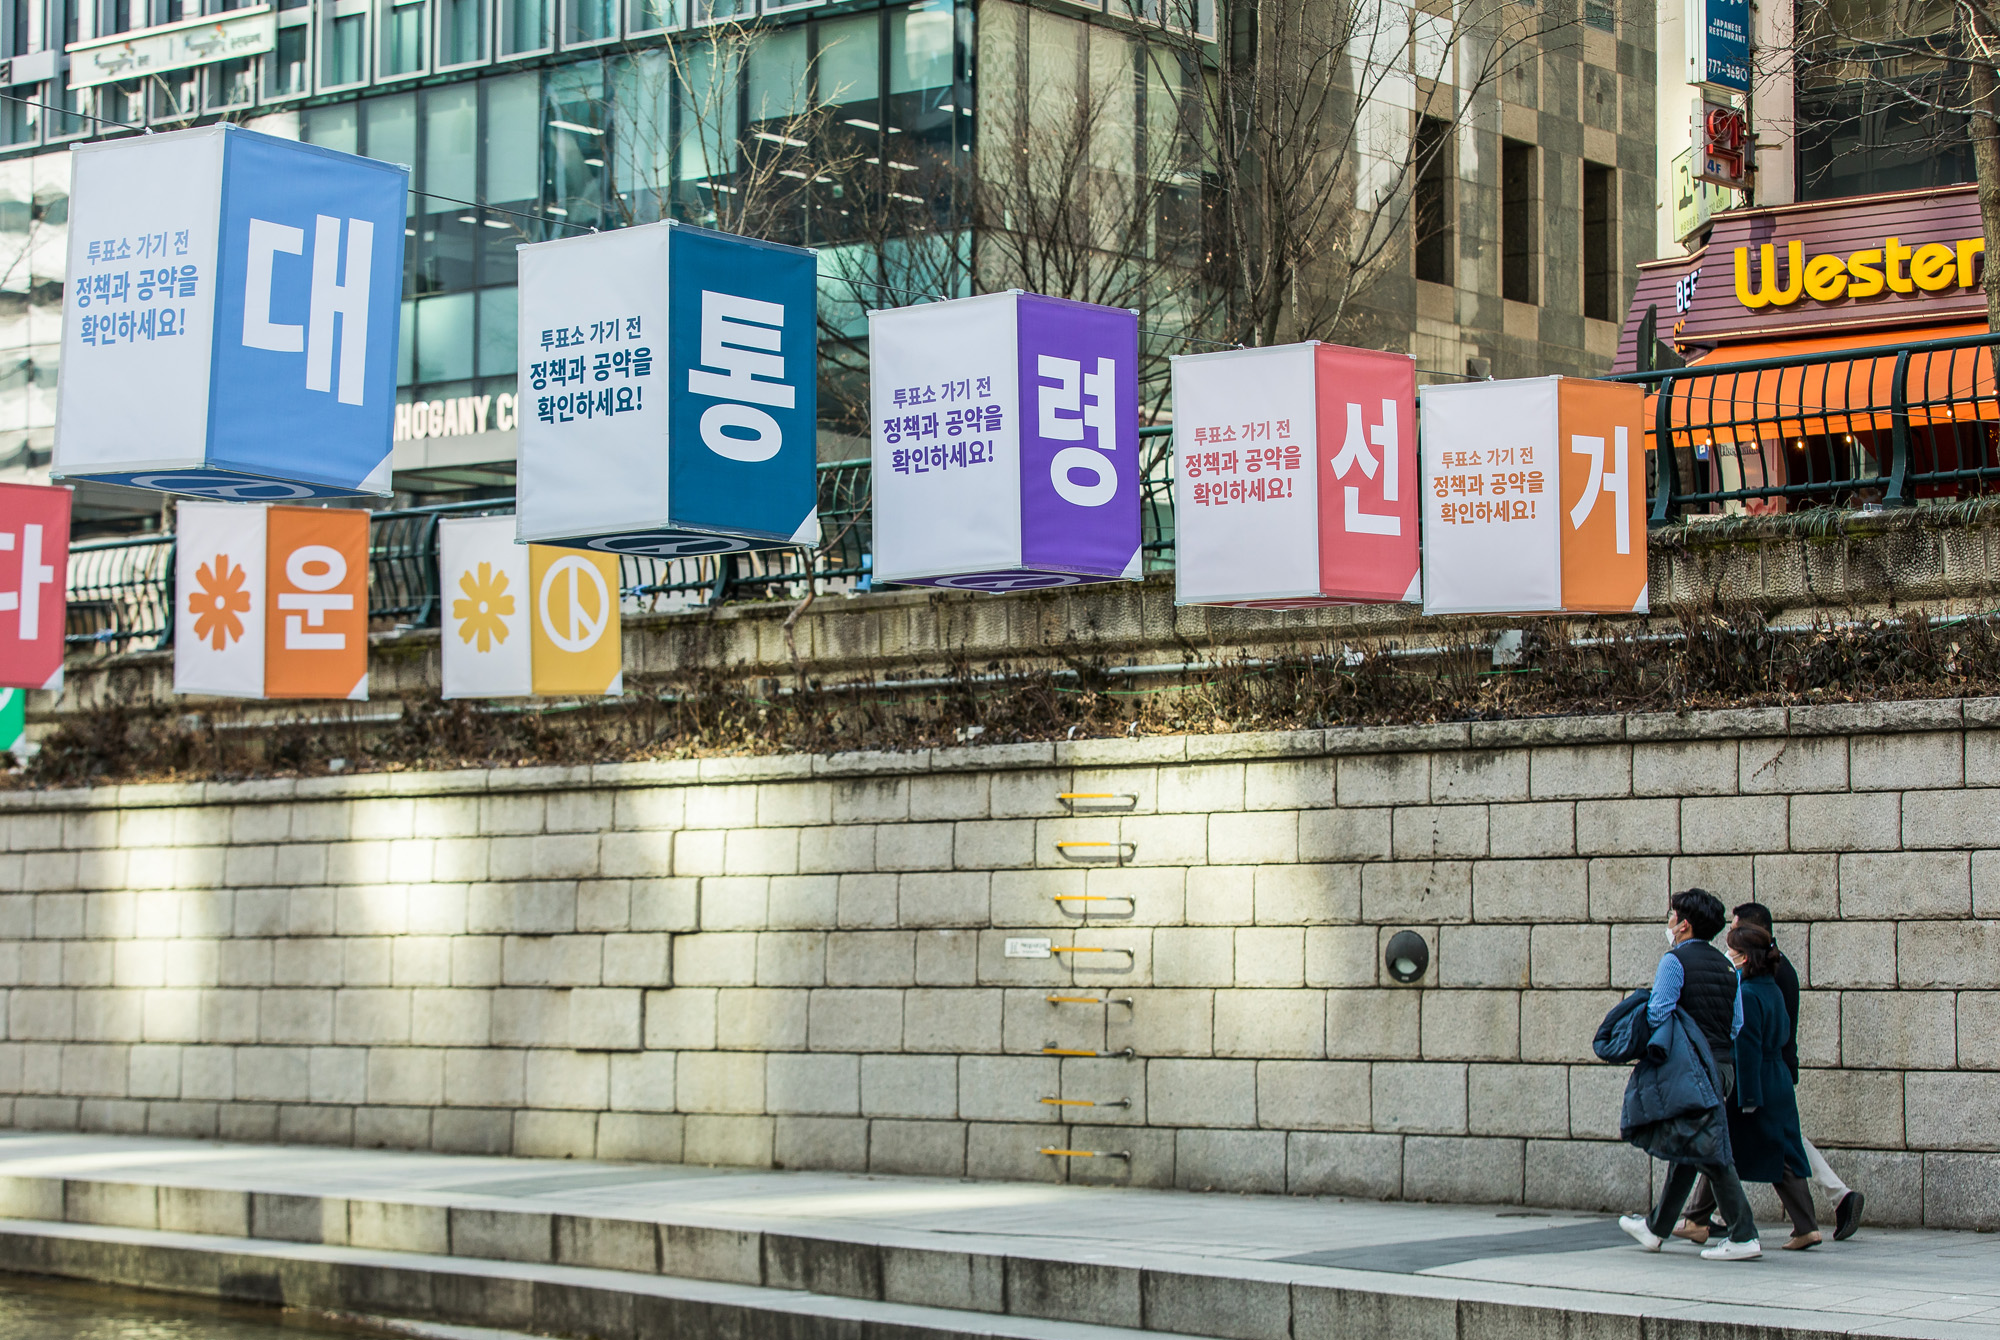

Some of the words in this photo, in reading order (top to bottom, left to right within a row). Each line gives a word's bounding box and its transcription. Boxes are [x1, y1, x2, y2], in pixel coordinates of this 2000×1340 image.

[1709, 26, 1746, 44] RESTAURANT
[1713, 18, 1741, 33] JAPANESE
[87, 240, 131, 265] 투표소
[136, 231, 168, 259] 가기
[173, 229, 189, 256] 전
[76, 271, 130, 308] 정책과
[137, 264, 199, 301] 공약을
[80, 308, 186, 347] 확인하세요!
[242, 214, 374, 406] 대
[540, 325, 585, 352] 투표소
[590, 318, 620, 345] 가기
[625, 315, 642, 340] 전
[529, 354, 586, 391] 정책과
[592, 346, 653, 383] 공약을
[688, 289, 796, 463] 통
[537, 386, 643, 425] 확인하세요!
[892, 384, 937, 409] 투표소
[941, 378, 970, 402] 가기
[976, 376, 991, 398] 전
[393, 395, 491, 441] HOGANY
[883, 412, 939, 444] 정책과
[945, 404, 1003, 437] 공약을
[1037, 353, 1118, 507] 령
[1194, 424, 1237, 447] 투표소
[1241, 420, 1270, 442] 가기
[1276, 418, 1290, 439] 전
[891, 440, 994, 475] 확인하세요!
[1185, 450, 1239, 478] 정책과
[1244, 445, 1302, 473] 공약을
[1330, 398, 1401, 536] 선
[1441, 450, 1483, 469] 투표소
[1486, 447, 1514, 467] 가기
[1519, 446, 1534, 465] 전
[1193, 477, 1293, 507] 확인하세요!
[1433, 473, 1484, 498] 정책과
[1490, 470, 1545, 496] 공약을
[1569, 425, 1630, 555] 거
[1440, 500, 1536, 525] 확인하세요!
[277, 545, 354, 650] 운
